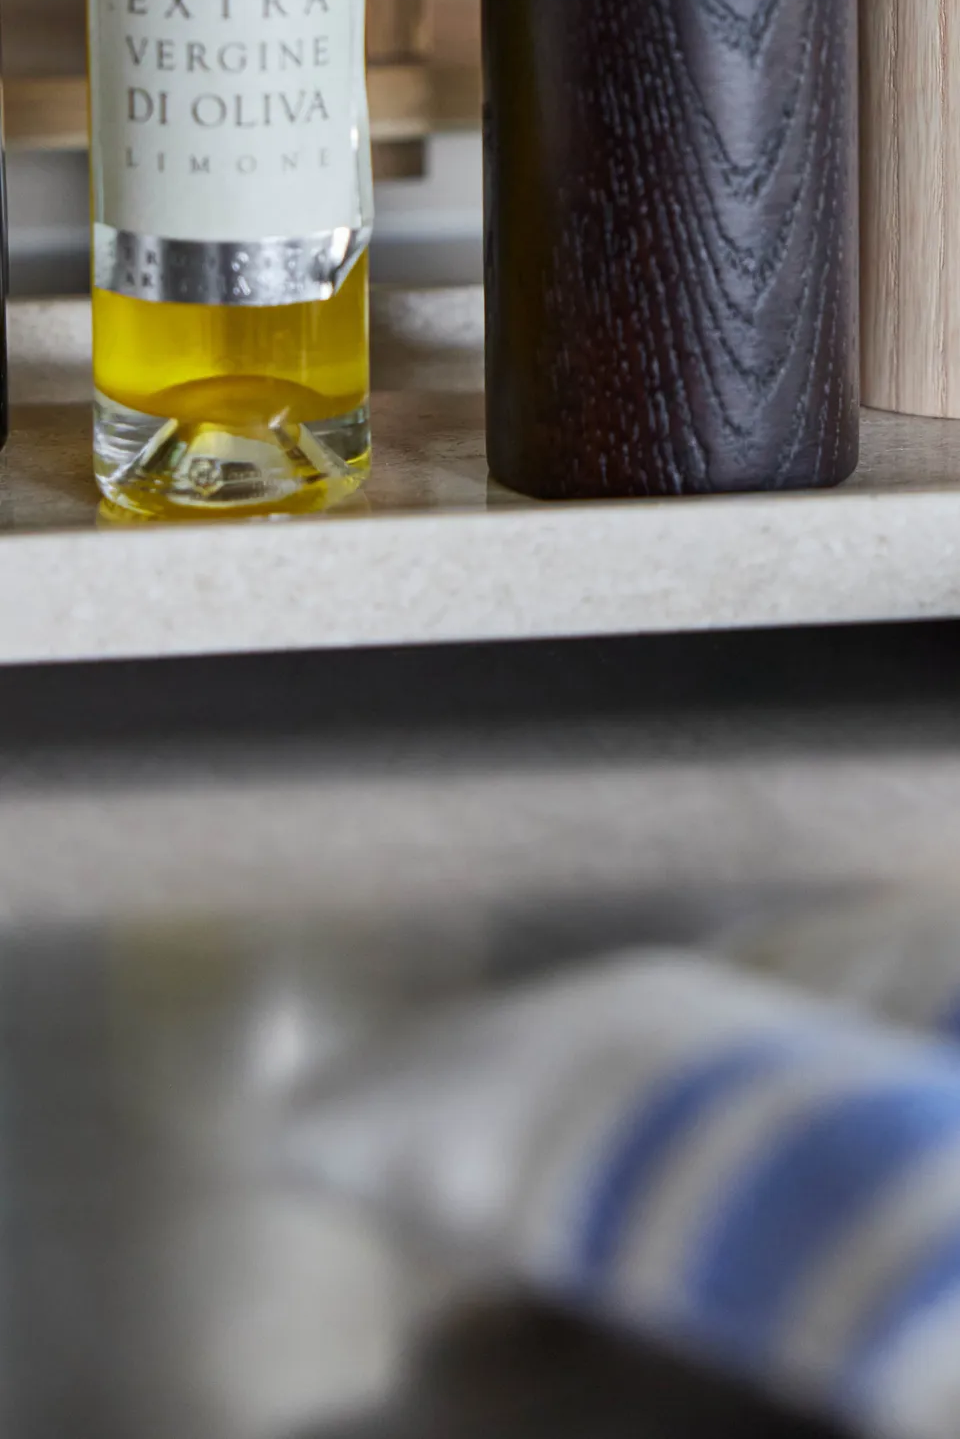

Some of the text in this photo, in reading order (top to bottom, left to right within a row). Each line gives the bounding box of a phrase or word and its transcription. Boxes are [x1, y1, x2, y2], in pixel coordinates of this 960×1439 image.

[125, 35, 330, 73] VERGINE
[127, 86, 330, 128] DI OLIVA
[125, 146, 330, 175] LIMONE
